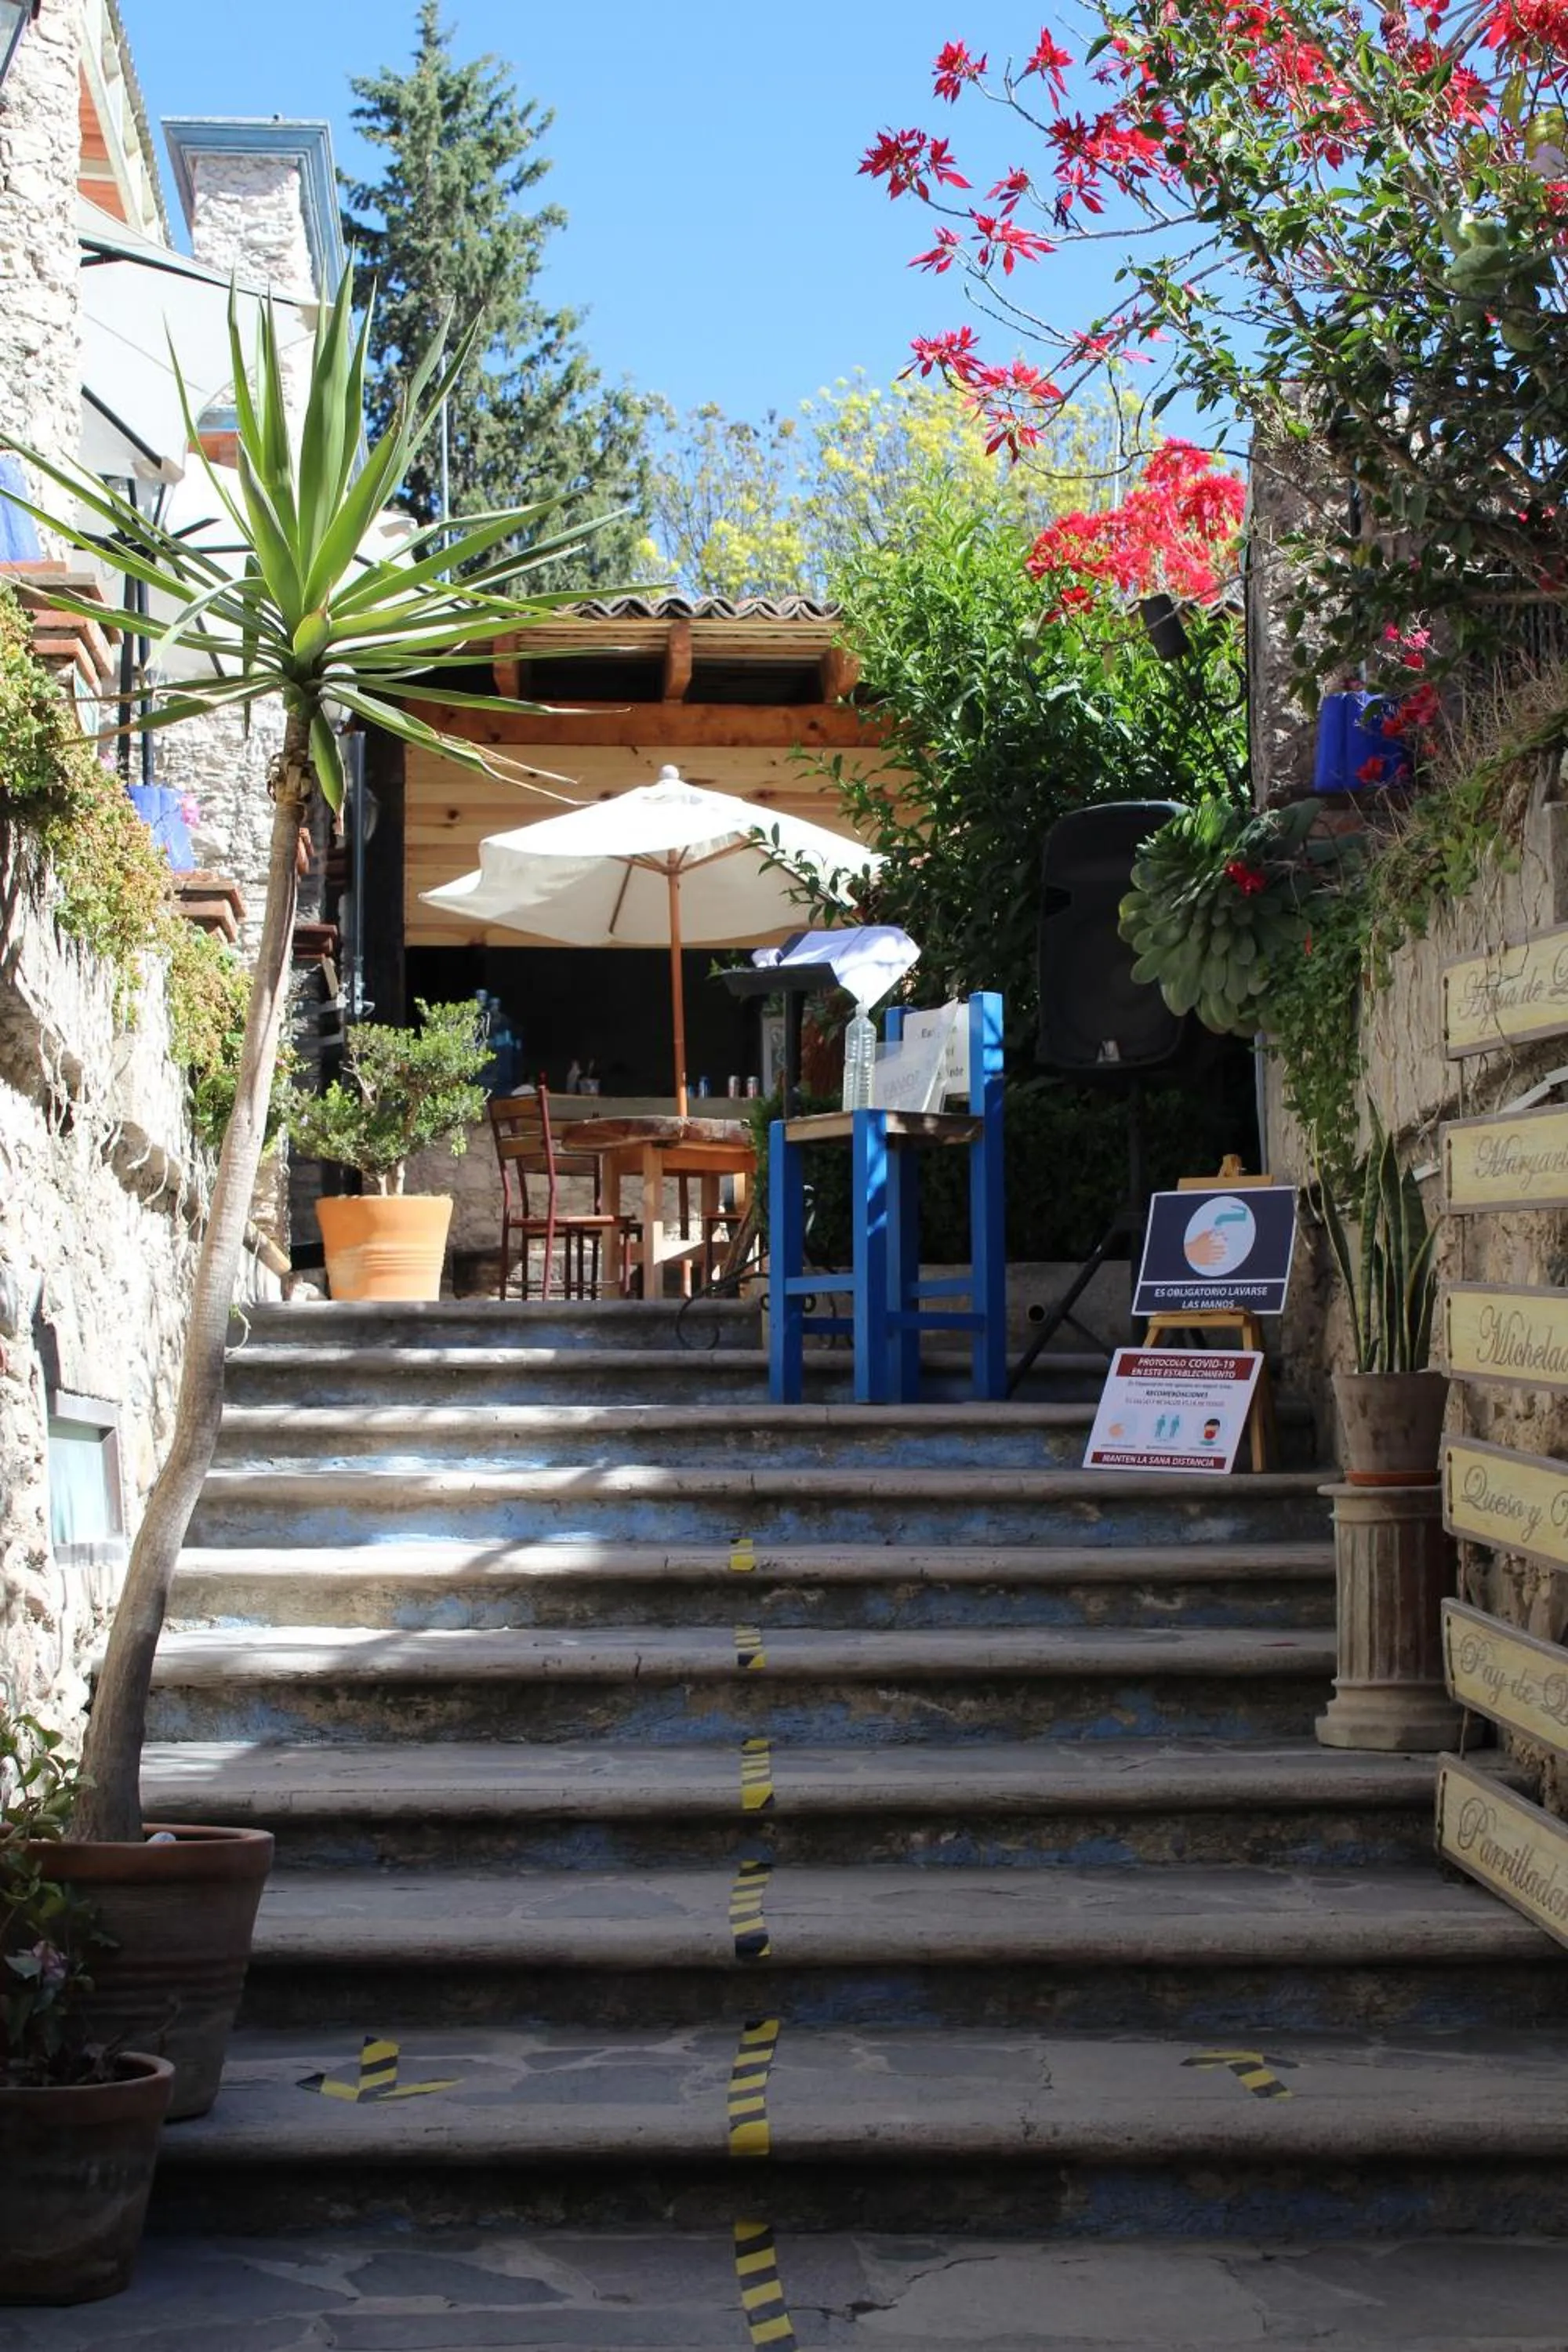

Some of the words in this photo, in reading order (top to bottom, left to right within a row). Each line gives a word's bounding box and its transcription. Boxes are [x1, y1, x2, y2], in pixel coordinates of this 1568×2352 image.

[1154, 1288, 1165, 1298] ES
[1167, 1287, 1226, 1297] OBLIGATORIO
[1228, 1287, 1268, 1296] LAVARSE
[1182, 1300, 1200, 1308] LAS
[1200, 1299, 1235, 1308] MANOS
[1138, 1357, 1186, 1367] PROTOCOLO
[1188, 1358, 1236, 1369] COVID-19
[1163, 1368, 1236, 1378] ESTABLECIMIENTO
[1149, 1456, 1171, 1465] SANA
[1172, 1457, 1214, 1467] DISTANCIA
[1461, 1465, 1523, 1520] Queso
[1521, 1504, 1544, 1543] y
[1460, 1632, 1505, 1706] Pay
[1511, 1668, 1533, 1704] de
[1457, 1797, 1568, 1920] Parrillada
